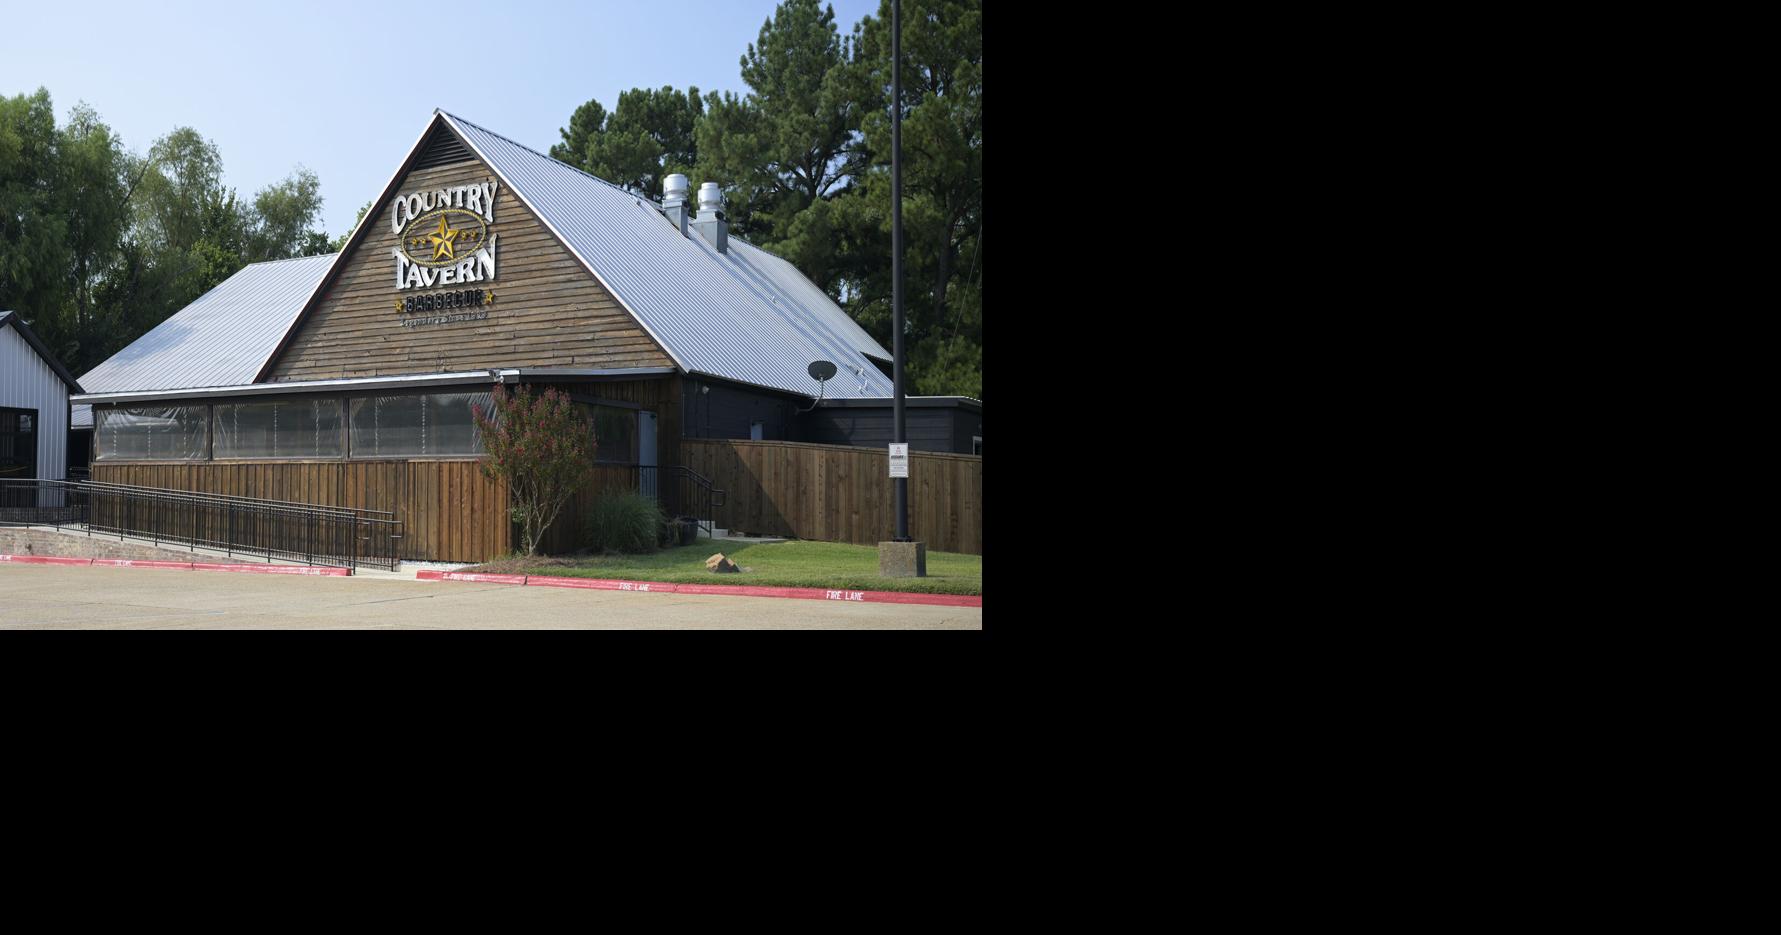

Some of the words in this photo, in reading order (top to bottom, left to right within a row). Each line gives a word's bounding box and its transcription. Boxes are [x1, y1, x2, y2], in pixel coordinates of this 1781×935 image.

[392, 181, 497, 234] COUNTRY
[392, 233, 497, 289] TAVERN
[407, 289, 484, 312] BARBECUE
[619, 582, 633, 590] FIRE
[634, 583, 650, 591] LANE
[826, 590, 842, 600] FIRE
[845, 591, 864, 601] LANE
